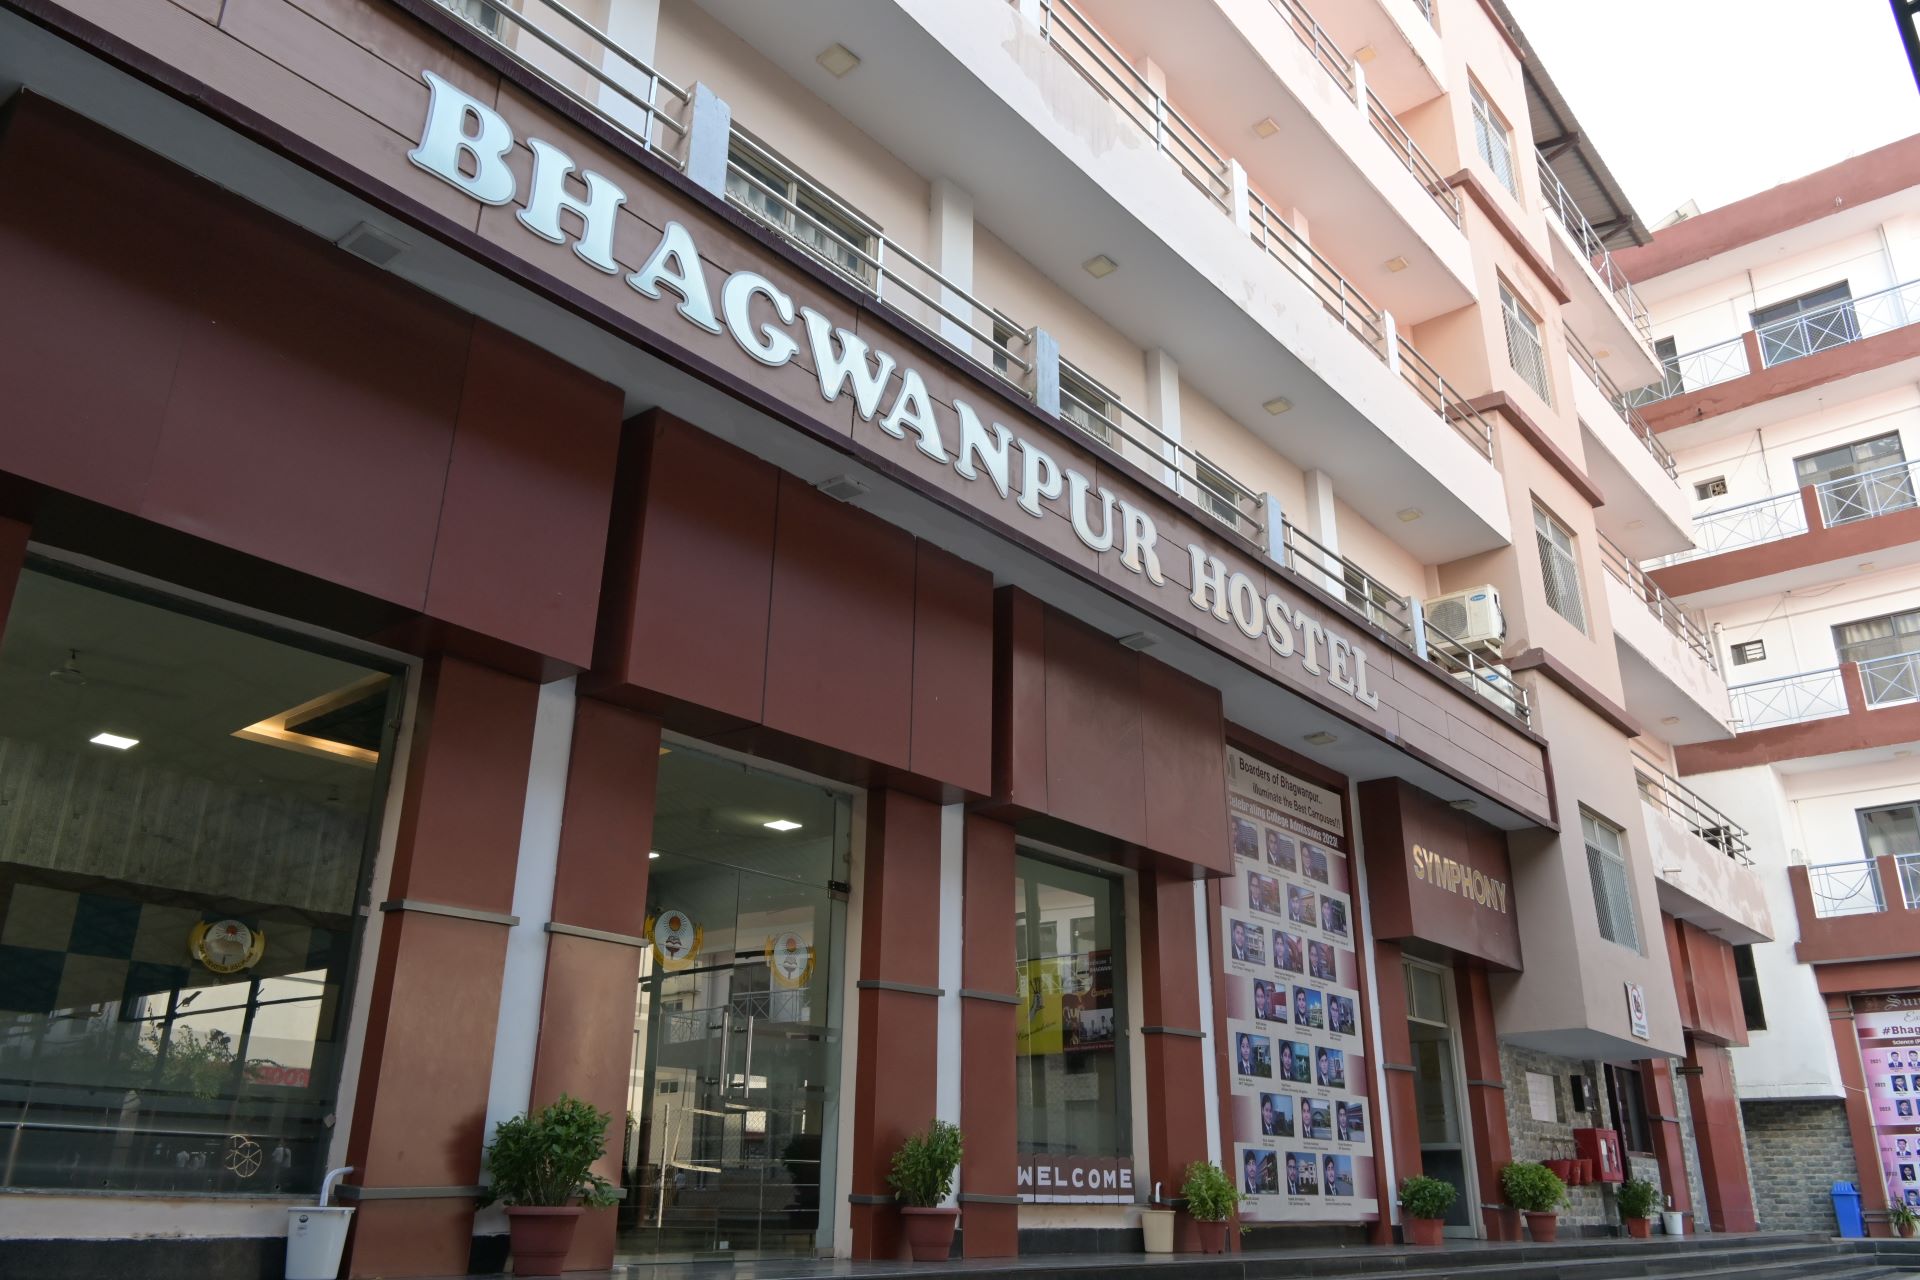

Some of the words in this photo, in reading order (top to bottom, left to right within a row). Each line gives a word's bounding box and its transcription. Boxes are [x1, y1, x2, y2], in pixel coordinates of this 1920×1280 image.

[407, 69, 1165, 587] BHAGWANPUR
[1186, 543, 1379, 711] HOSTEL
[1239, 757, 1271, 783] Boarders
[1272, 774, 1280, 785] of
[1230, 797, 1266, 820] elebrating
[1266, 808, 1289, 828] College
[1289, 818, 1322, 841] Admissions
[1283, 795, 1293, 809] the
[1293, 800, 1308, 817] Best
[1413, 844, 1506, 914] SYMPHONY
[1017, 1166, 1133, 1189] WELCOME
